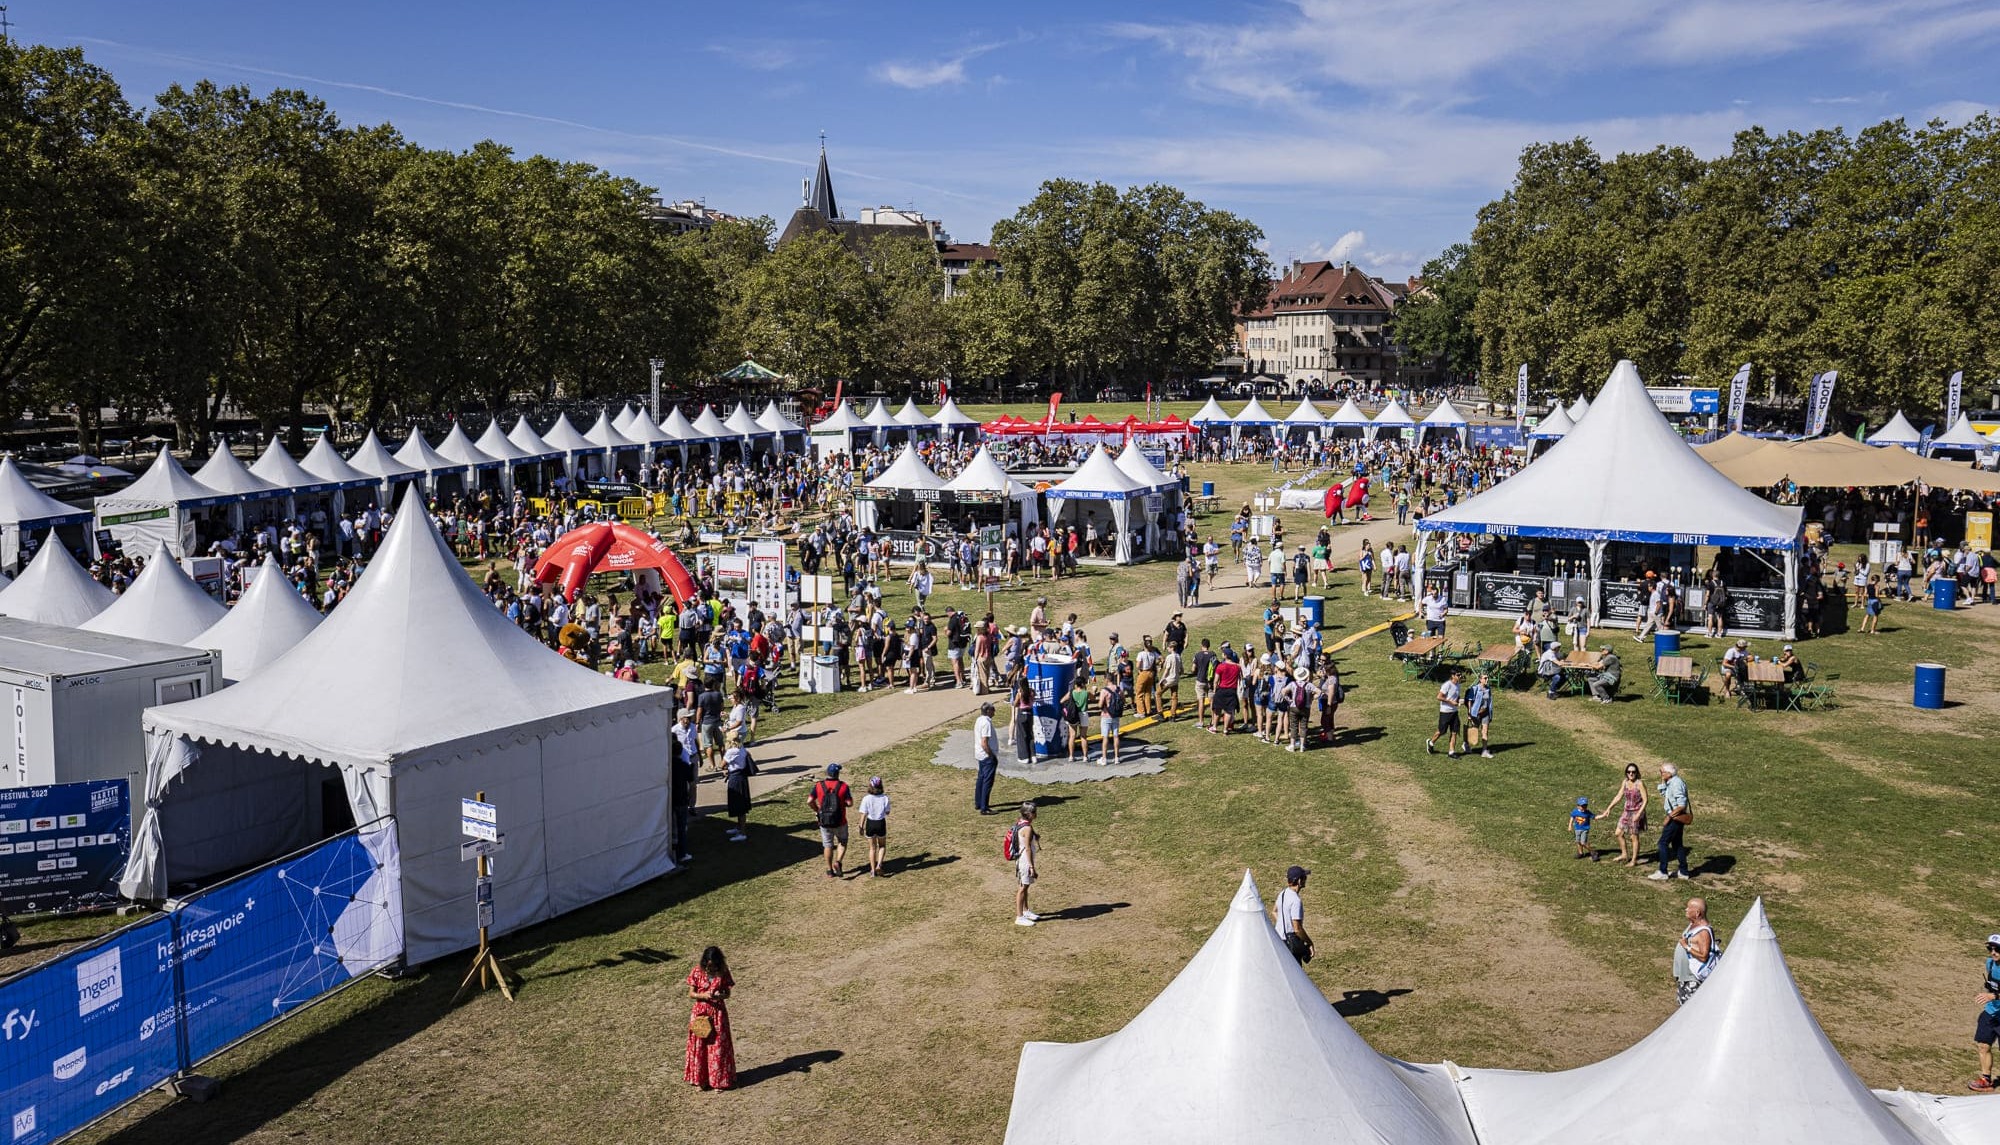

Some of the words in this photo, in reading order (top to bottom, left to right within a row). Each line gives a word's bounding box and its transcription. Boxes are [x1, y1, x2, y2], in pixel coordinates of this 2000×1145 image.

[1486, 524, 1518, 535] BUVETTE
[1672, 533, 1708, 545] BUVETTE
[1361, 559, 1371, 571] K
[15, 689, 26, 782] TOILET
[1, 791, 29, 800] FESTIVAL
[31, 789, 48, 798] 2023
[79, 973, 116, 999] mgen
[95, 1066, 135, 1096] esf
